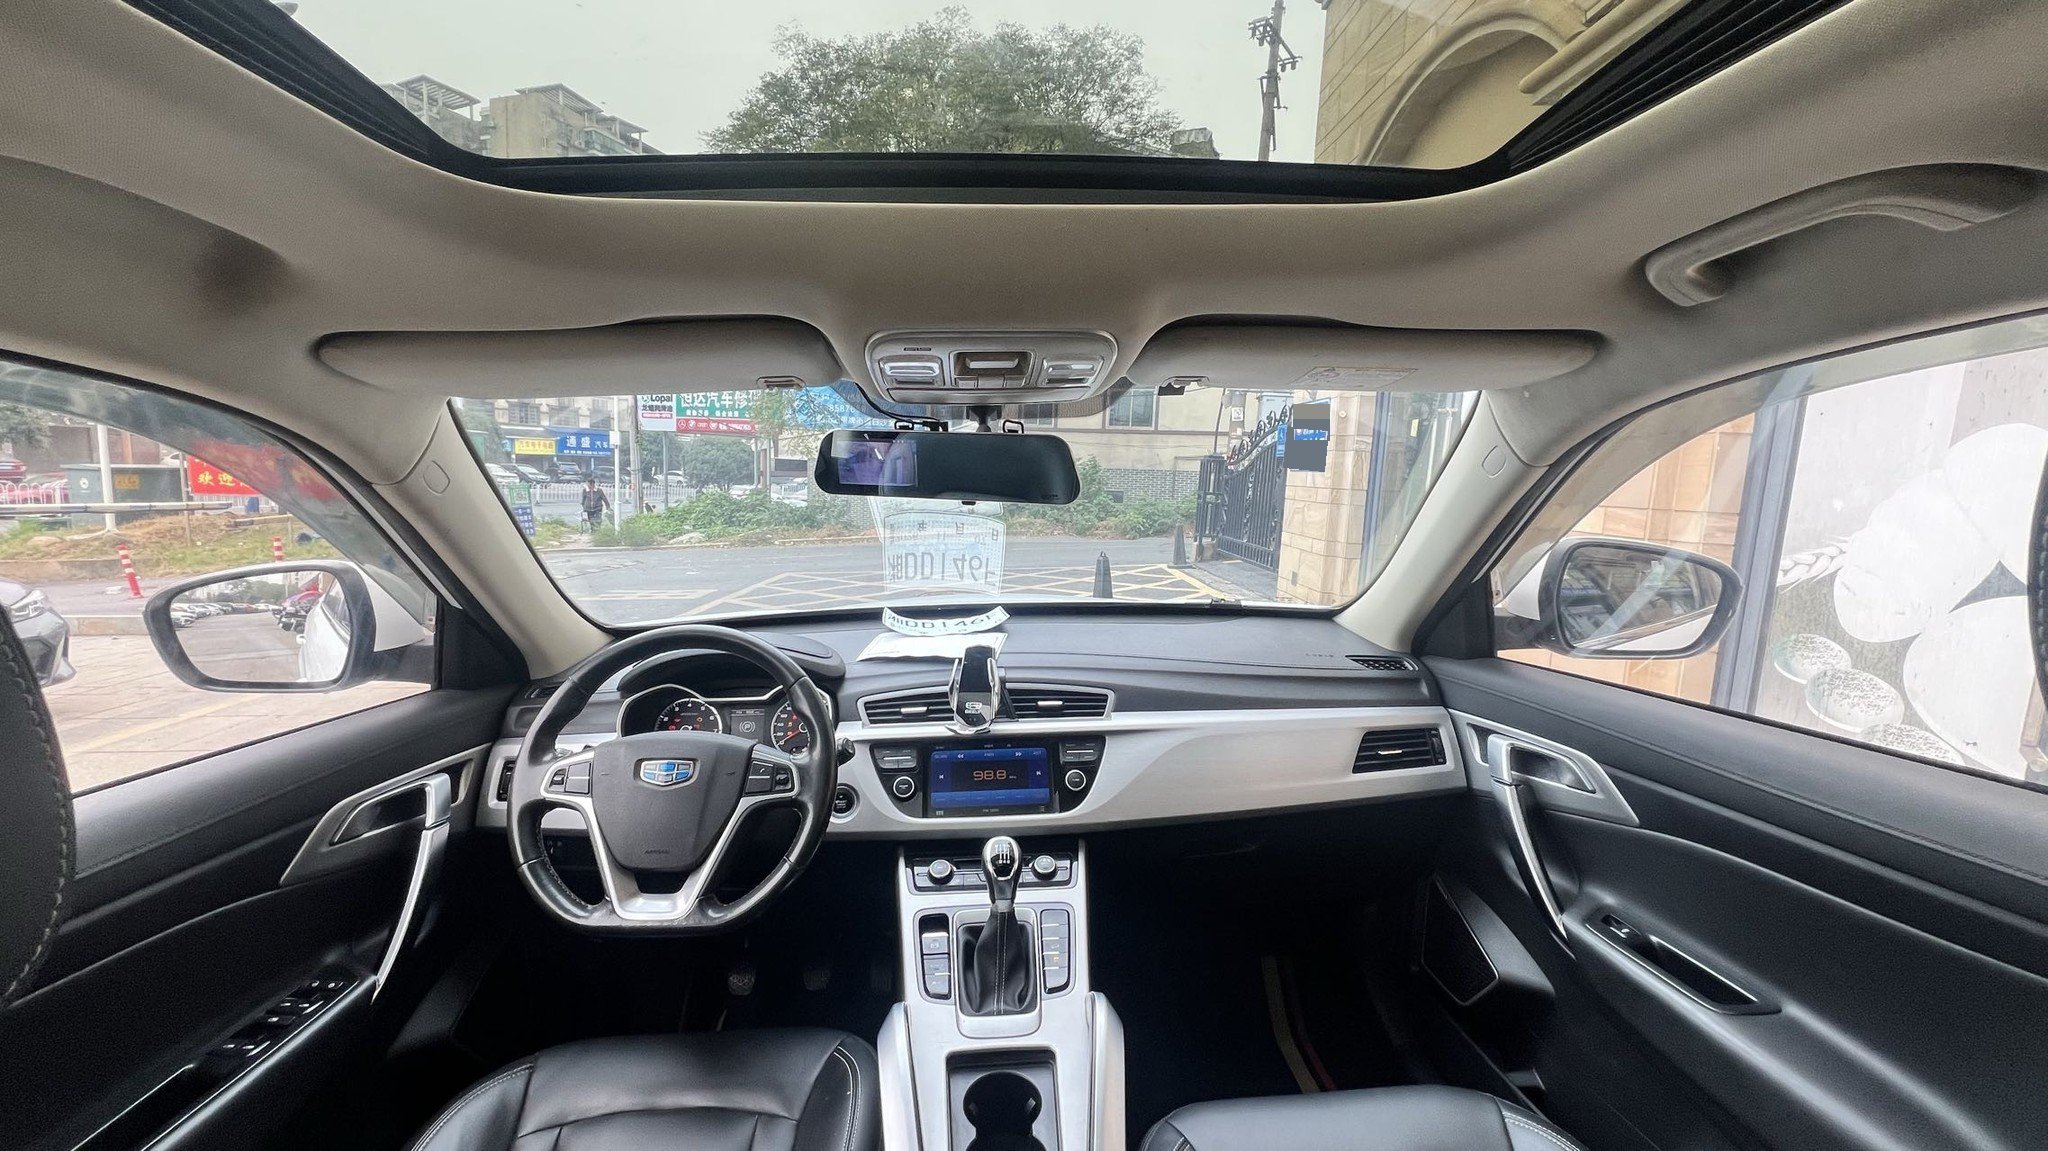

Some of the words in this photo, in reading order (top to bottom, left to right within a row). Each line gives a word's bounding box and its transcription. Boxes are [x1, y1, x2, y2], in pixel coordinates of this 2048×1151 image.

[650, 394, 673, 404] Lopal
[566, 435, 591, 448] 通盛
[973, 769, 1007, 781] 98.8
